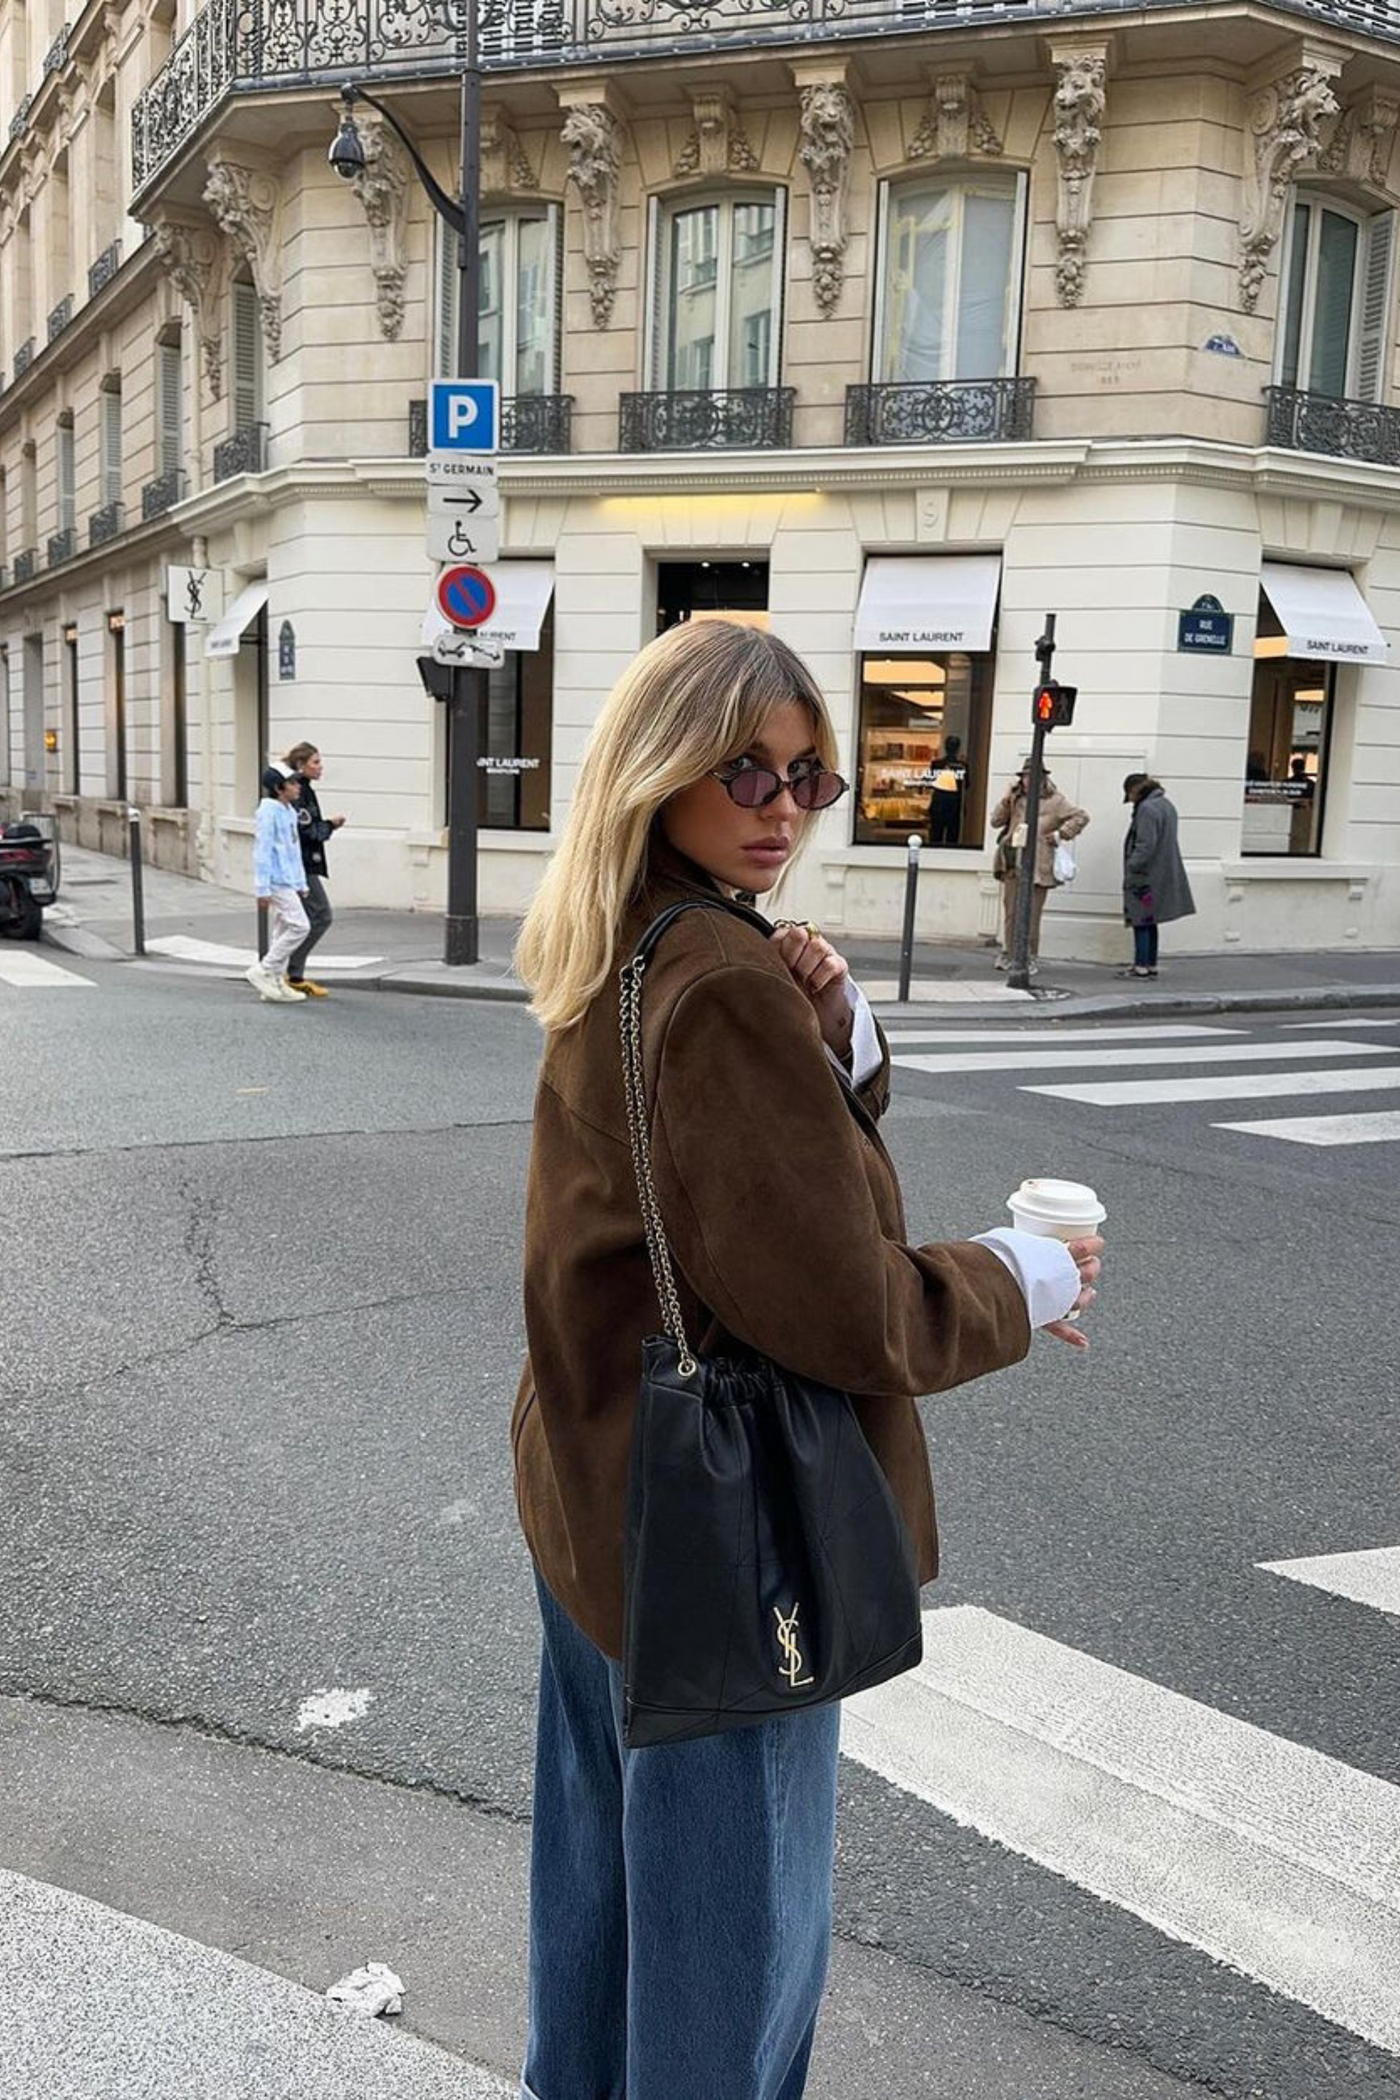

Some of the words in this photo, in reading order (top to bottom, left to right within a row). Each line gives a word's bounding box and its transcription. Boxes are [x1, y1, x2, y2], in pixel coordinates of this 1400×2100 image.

[448, 394, 479, 439] P
[443, 463, 494, 476] GERMAIN
[184, 570, 207, 621] YSL
[1199, 620, 1213, 630] RUE
[879, 632, 910, 642] SAINT
[913, 632, 964, 642] LAURENT
[1306, 639, 1330, 651] SAINT
[1331, 643, 1369, 654] LAURENT
[496, 758, 540, 769] LAURENT
[773, 1602, 815, 1687] YSL
